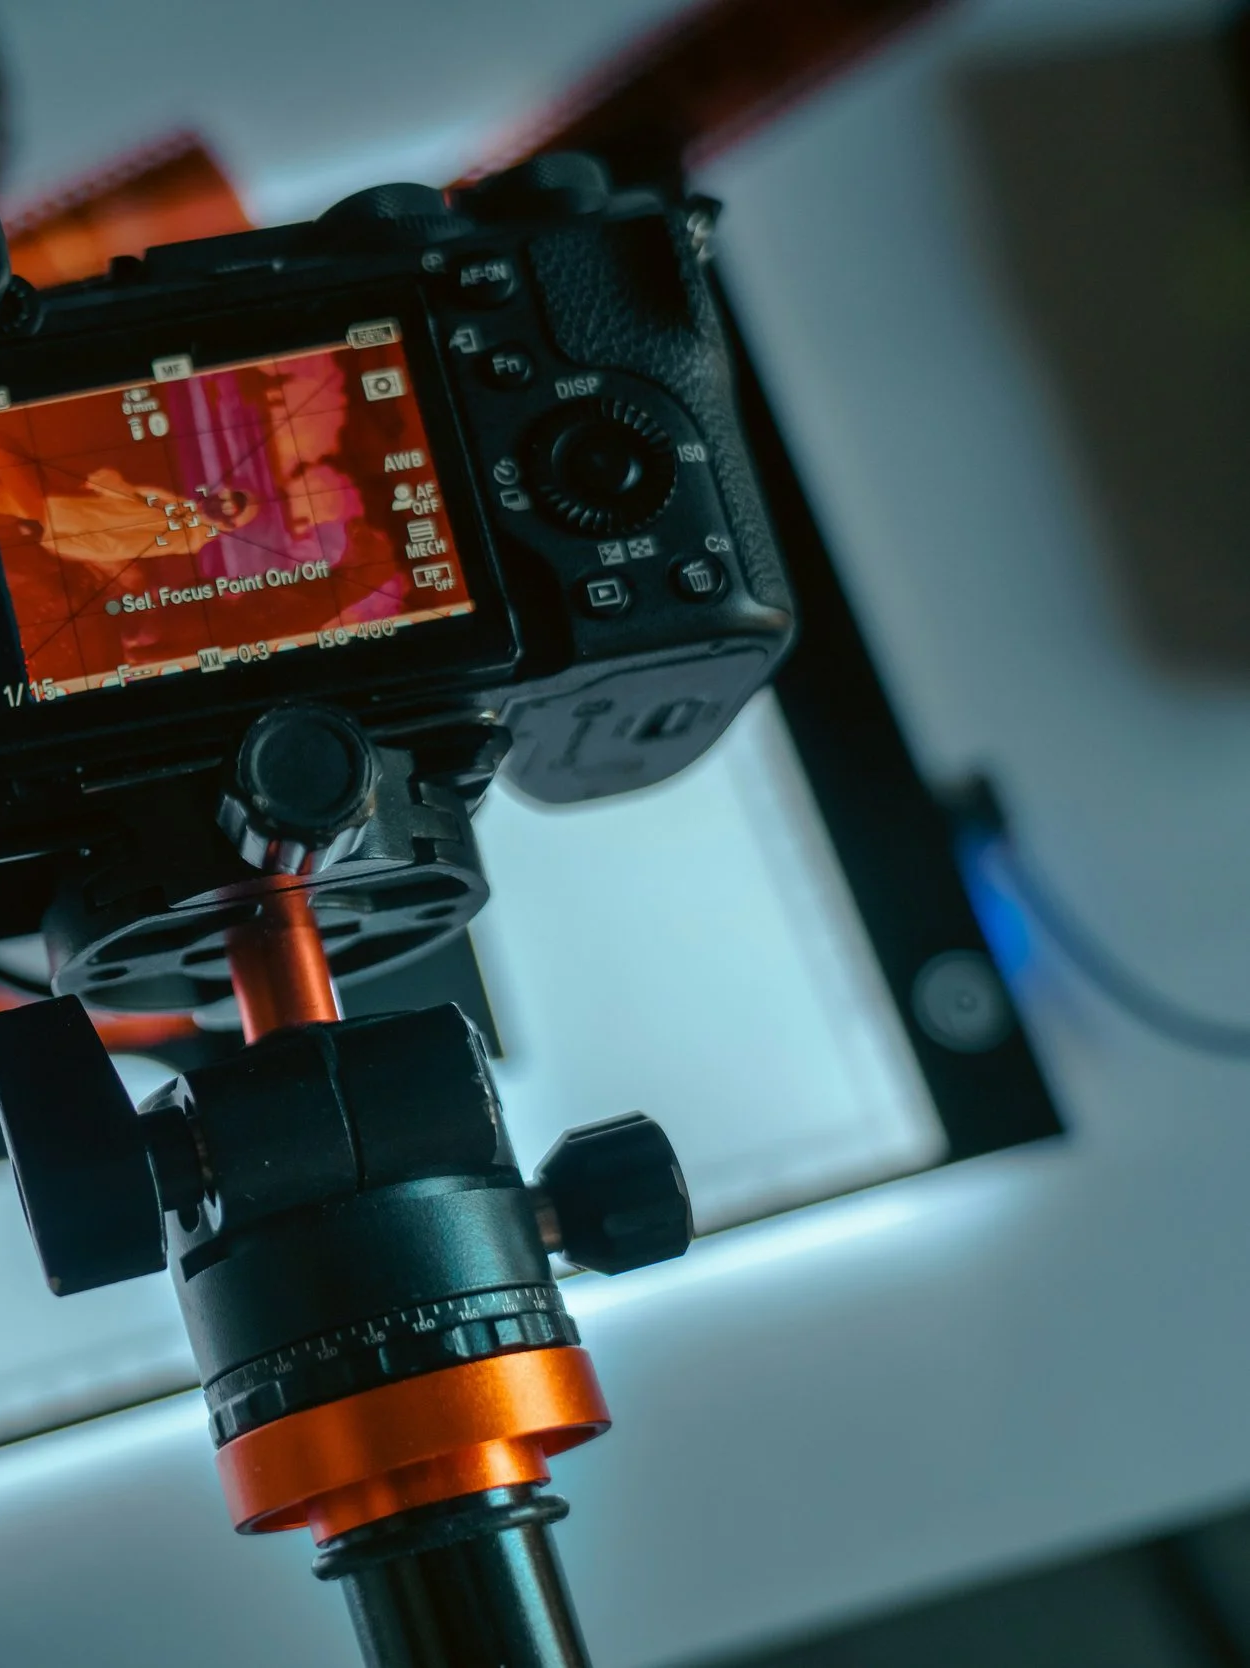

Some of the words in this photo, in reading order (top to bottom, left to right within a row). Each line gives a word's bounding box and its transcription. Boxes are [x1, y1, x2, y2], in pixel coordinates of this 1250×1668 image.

[460, 263, 508, 287] AF-ON
[492, 356, 520, 375] Fn
[554, 375, 599, 400] DISP
[384, 449, 425, 473] AWB
[677, 444, 706, 463] ISO
[416, 482, 437, 501] AF
[412, 499, 440, 515] OFF
[405, 539, 447, 559] MECH
[705, 535, 731, 553] C3
[424, 568, 441, 582] PP
[121, 592, 156, 613] Sel.
[158, 584, 215, 607] Focus
[215, 573, 264, 597] Point
[265, 559, 330, 588] On/Off
[434, 578, 456, 592] OFF
[316, 626, 350, 649] ISO
[357, 618, 396, 640] 400
